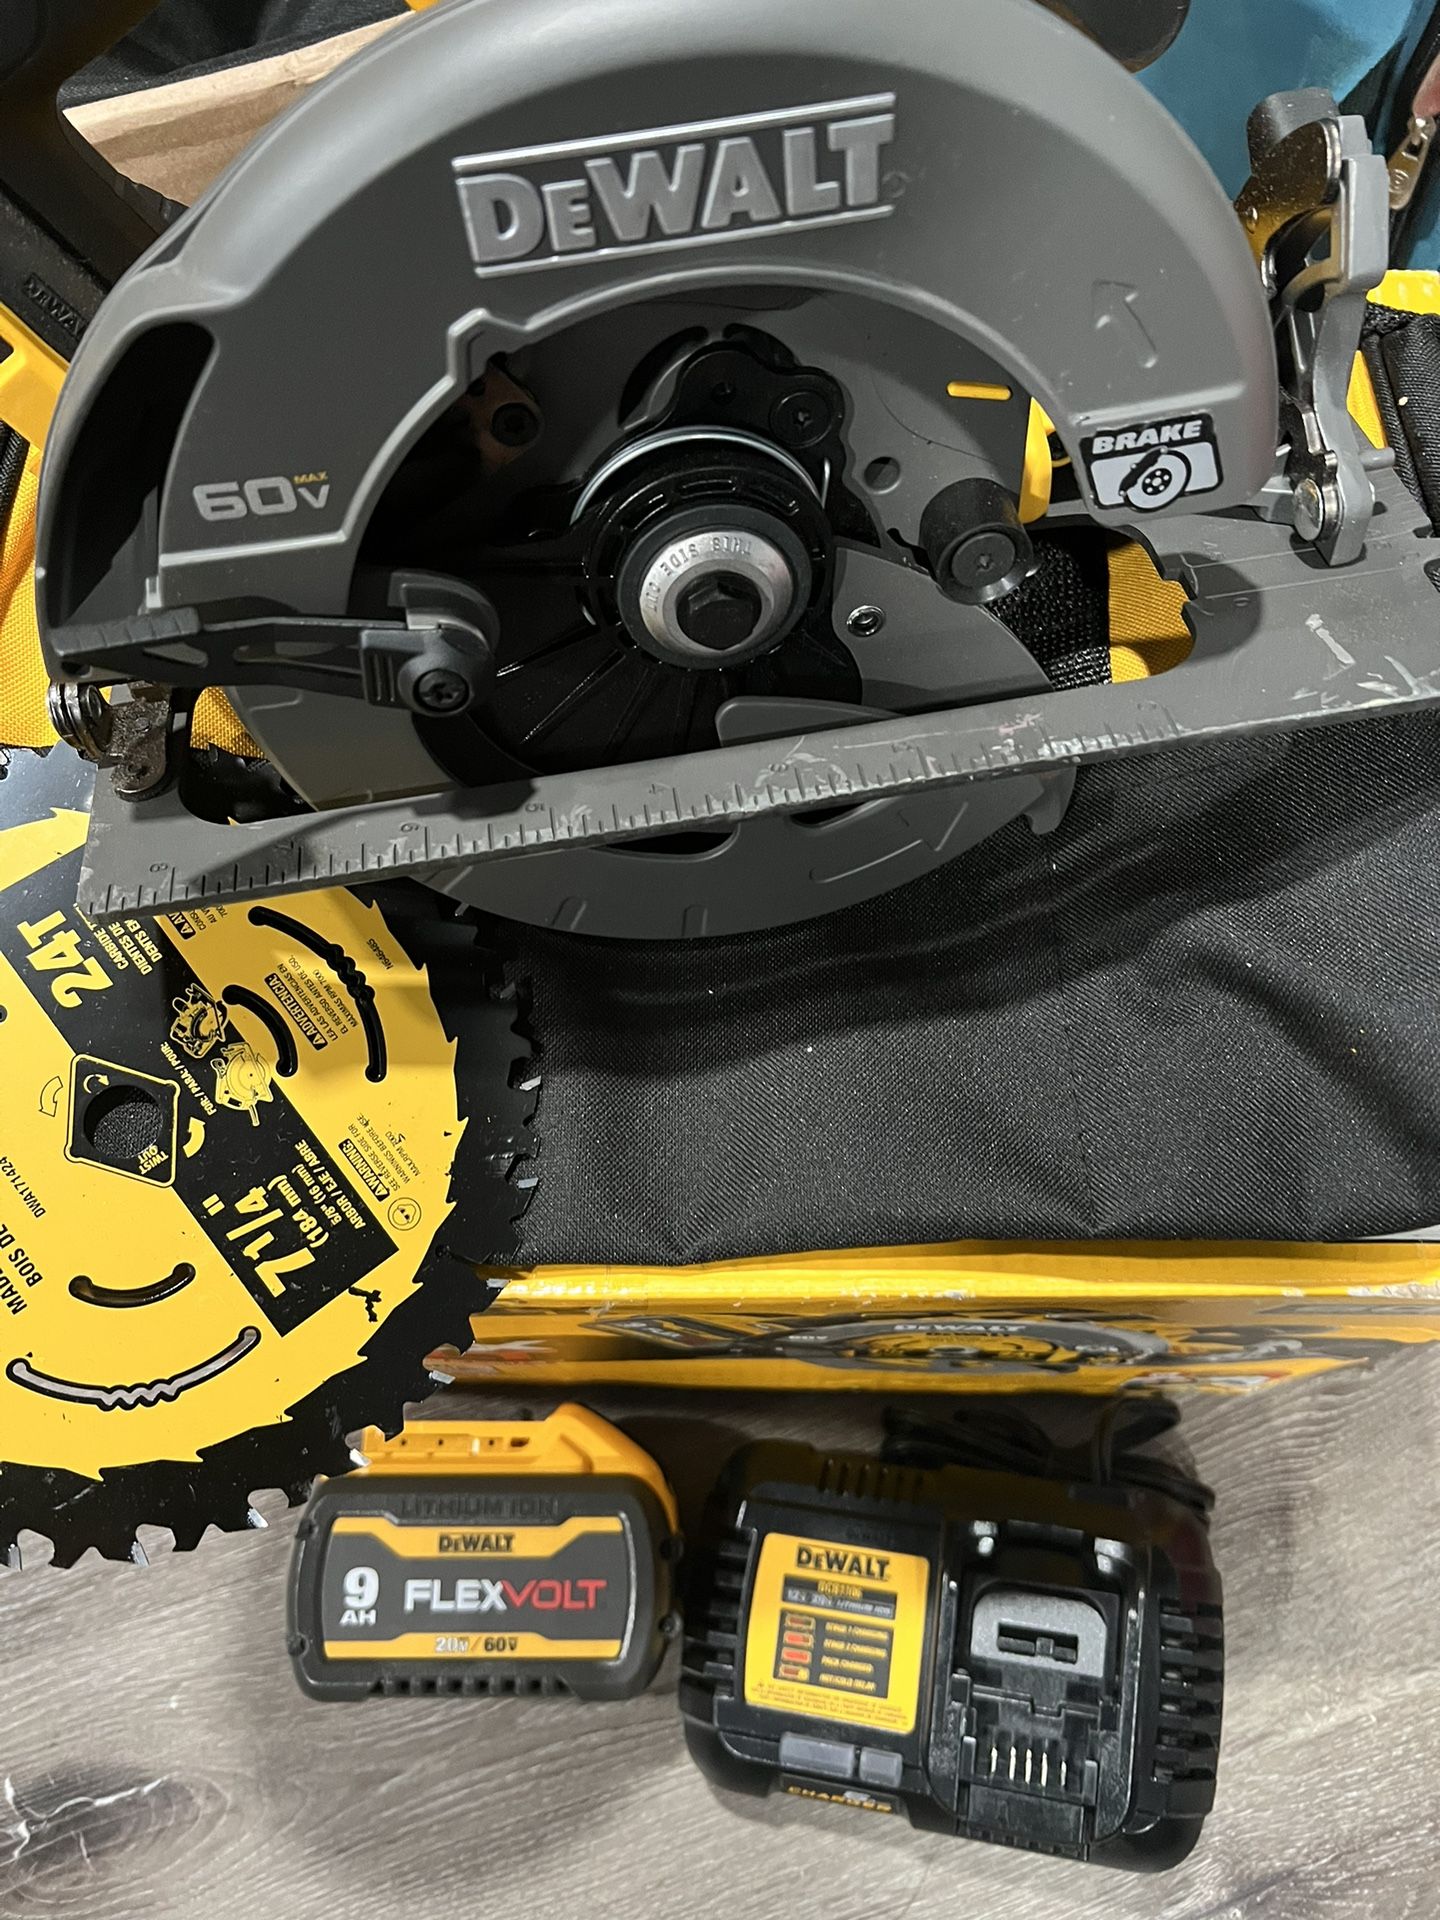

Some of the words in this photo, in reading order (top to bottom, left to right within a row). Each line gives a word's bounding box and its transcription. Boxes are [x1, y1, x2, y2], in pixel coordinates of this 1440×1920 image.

[456, 114, 895, 263] DEWALT
[1092, 420, 1203, 455] BRAKE
[107, 920, 126, 937] DE
[15, 909, 114, 1008] 24T
[92, 926, 129, 970] CARBIDE
[117, 933, 153, 975] DIENTES
[133, 929, 163, 962] DENTS
[276, 962, 288, 974] EN
[296, 969, 308, 981] DE
[282, 971, 321, 1016] ADVERTENCIAS
[303, 977, 323, 999] ANTES
[322, 983, 338, 999] RPM
[268, 971, 318, 1036] ADVERTENCIA:
[318, 997, 343, 1026] REVERSO
[315, 1014, 330, 1029] LAS
[325, 1026, 339, 1041] LEA
[339, 1023, 349, 1034] EL
[159, 1040, 181, 1067] POUR:
[179, 1067, 201, 1094] PARA:
[199, 1094, 217, 1116] FOR:
[347, 1122, 361, 1138] FOR
[365, 1126, 388, 1152] BEFORE
[137, 1144, 159, 1164] OUT
[294, 1138, 321, 1167] ABRE
[356, 1135, 372, 1153] SIDE
[138, 1149, 169, 1175] TWIST
[290, 1162, 316, 1187] mm)
[342, 1137, 383, 1192] WARNING:
[367, 1149, 392, 1180] REVERSE
[382, 1149, 411, 1184] WARNINGS
[0, 1155, 47, 1218] DWA171424
[266, 1173, 302, 1207] mm)
[308, 1183, 327, 1204] (16
[317, 1169, 338, 1192] EJE
[387, 1176, 401, 1191] SEE
[319, 1202, 343, 1225] 5/8"
[335, 1193, 367, 1229] ARBOR
[291, 1207, 330, 1248] (184
[7, 1247, 44, 1287] BOIS
[0, 1266, 28, 1315] MAD
[439, 1534, 515, 1552] DEWALT
[796, 1544, 892, 1581] DEWALT
[343, 1567, 380, 1608] 9
[404, 1578, 607, 1614] FLEXVOLT
[340, 1609, 377, 1626] AH
